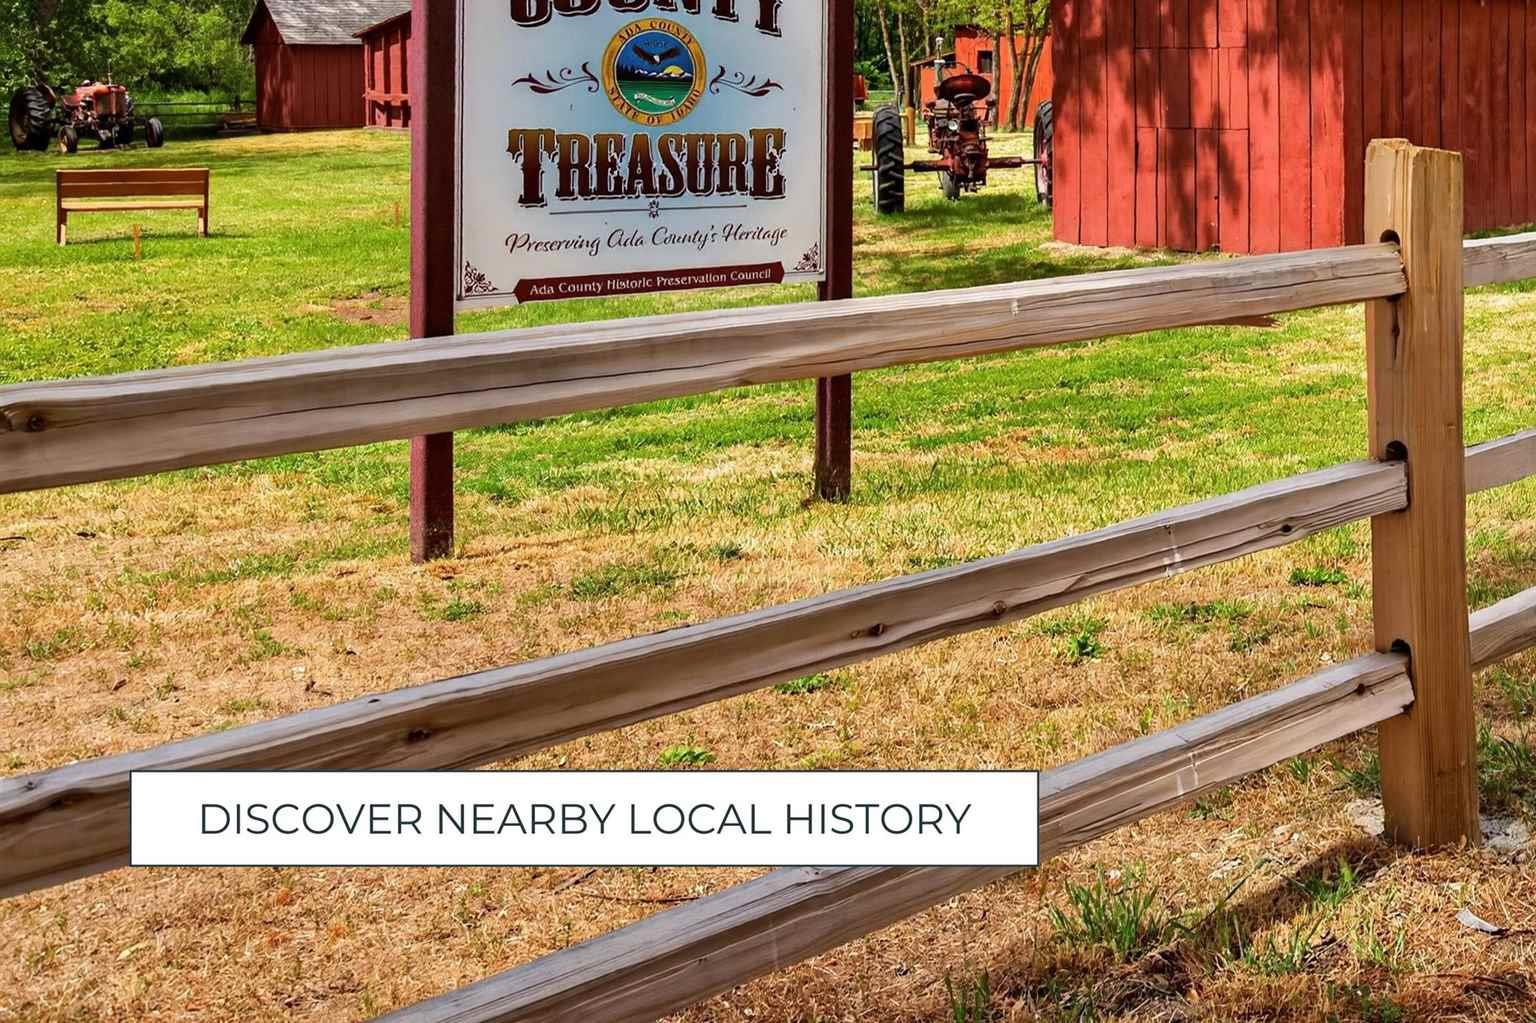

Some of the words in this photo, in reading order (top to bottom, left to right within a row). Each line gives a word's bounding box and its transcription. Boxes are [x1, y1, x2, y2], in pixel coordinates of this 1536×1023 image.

[619, 23, 642, 43] ADA
[649, 20, 694, 45] COUNTY
[608, 87, 638, 119] STATE
[647, 116, 661, 125] OF
[671, 88, 701, 121] IDAHO
[506, 128, 788, 209] TREASURE
[504, 233, 601, 257] Preserving
[607, 228, 645, 249] Ada
[651, 225, 718, 252] County's
[721, 223, 788, 246] Heritage
[529, 284, 555, 296] Ada
[558, 281, 604, 295] County
[606, 277, 653, 291] Historic
[656, 272, 727, 287] Preservation
[730, 268, 772, 282] Council
